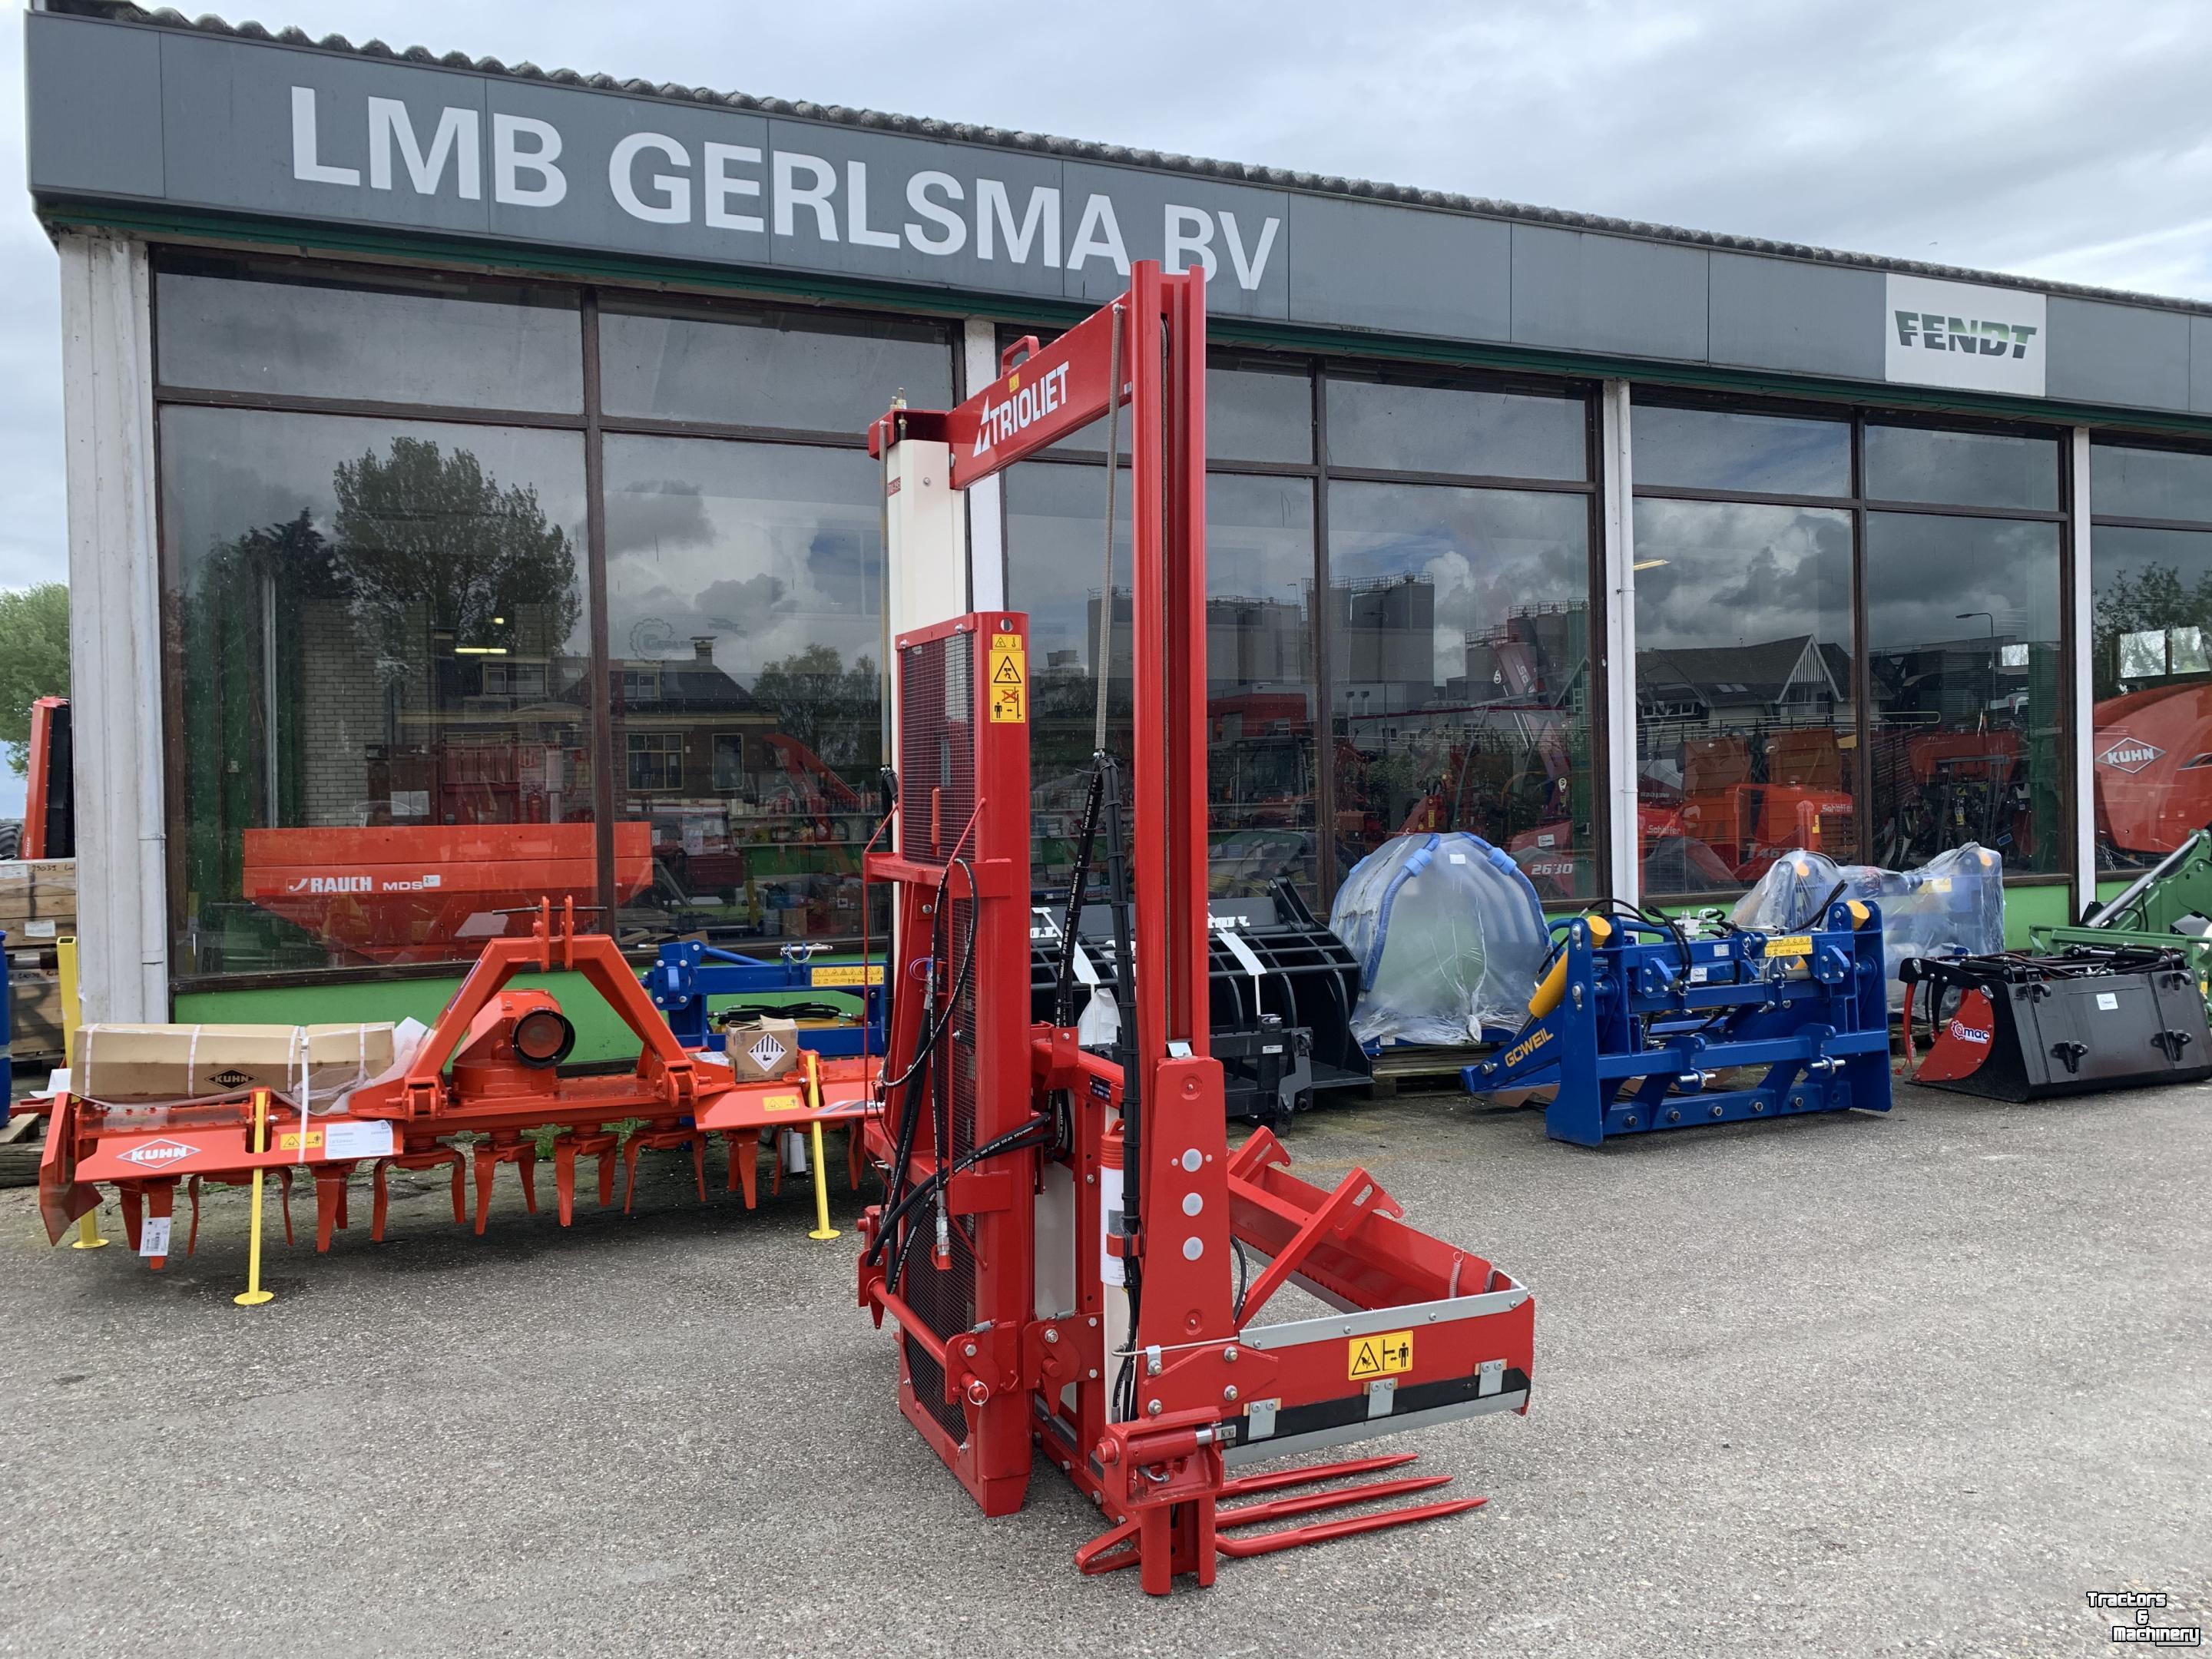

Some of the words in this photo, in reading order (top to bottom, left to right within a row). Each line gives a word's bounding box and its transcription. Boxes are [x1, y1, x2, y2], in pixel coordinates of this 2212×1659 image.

[291, 85, 568, 207] LMB
[608, 131, 1131, 276] GERLSMA
[1164, 204, 1280, 291] BV
[1894, 310, 2038, 359] FENDT
[989, 361, 1069, 445] TRIOLIET
[2107, 748, 2154, 765] KUHN
[1531, 863, 1574, 875] 2630
[310, 876, 373, 892] RAUCH
[382, 881, 423, 891] MDS
[131, 1147, 187, 1161] KUHN
